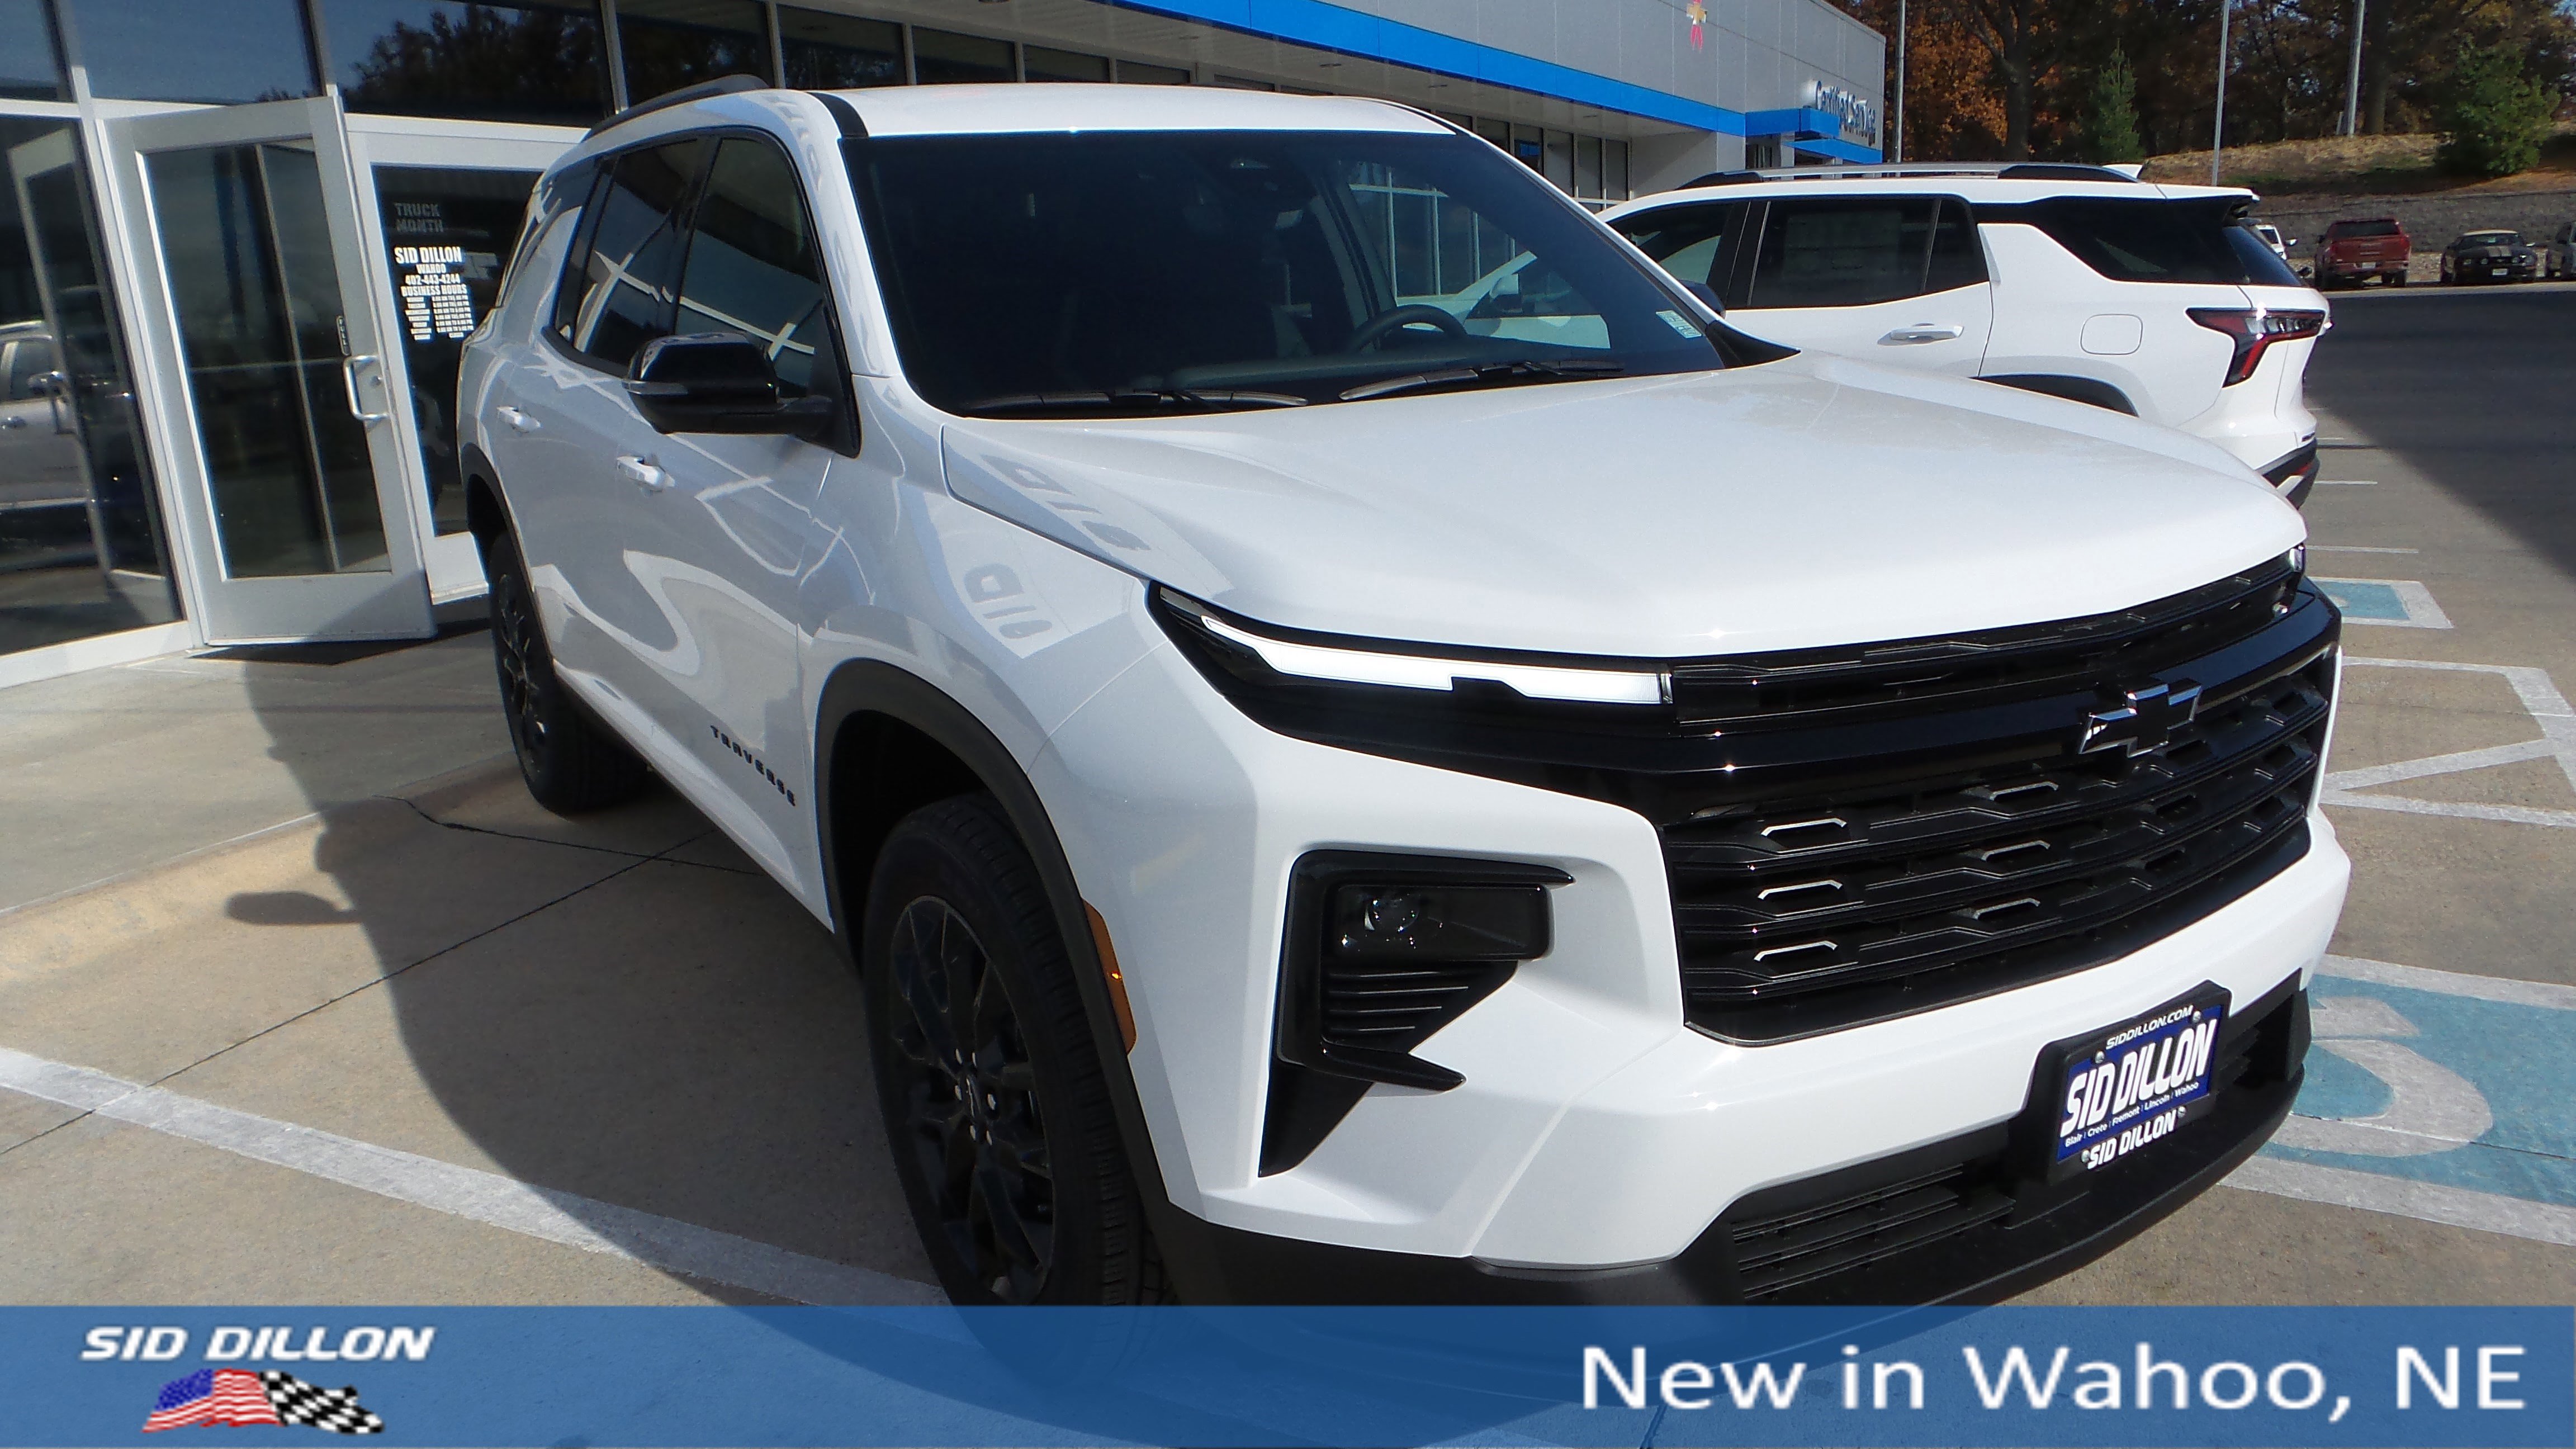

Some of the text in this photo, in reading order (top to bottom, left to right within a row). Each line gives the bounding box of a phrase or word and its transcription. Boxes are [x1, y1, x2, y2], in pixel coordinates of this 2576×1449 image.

[394, 202, 440, 217] TRUCK
[394, 246, 462, 264] SID DILLON
[416, 263, 446, 274] WAHOO
[400, 283, 467, 296] BUSINESS HOURS
[405, 273, 461, 286] 402-443-4244
[710, 725, 795, 807] TRAVERSE
[2105, 1005, 2194, 1050] SIDDILLON.COM
[2060, 1019, 2218, 1138] SID DILLON
[2065, 1133, 2083, 1148] Blair
[2112, 1106, 2140, 1126] Fremont
[2087, 1108, 2177, 1169] SID DILLON
